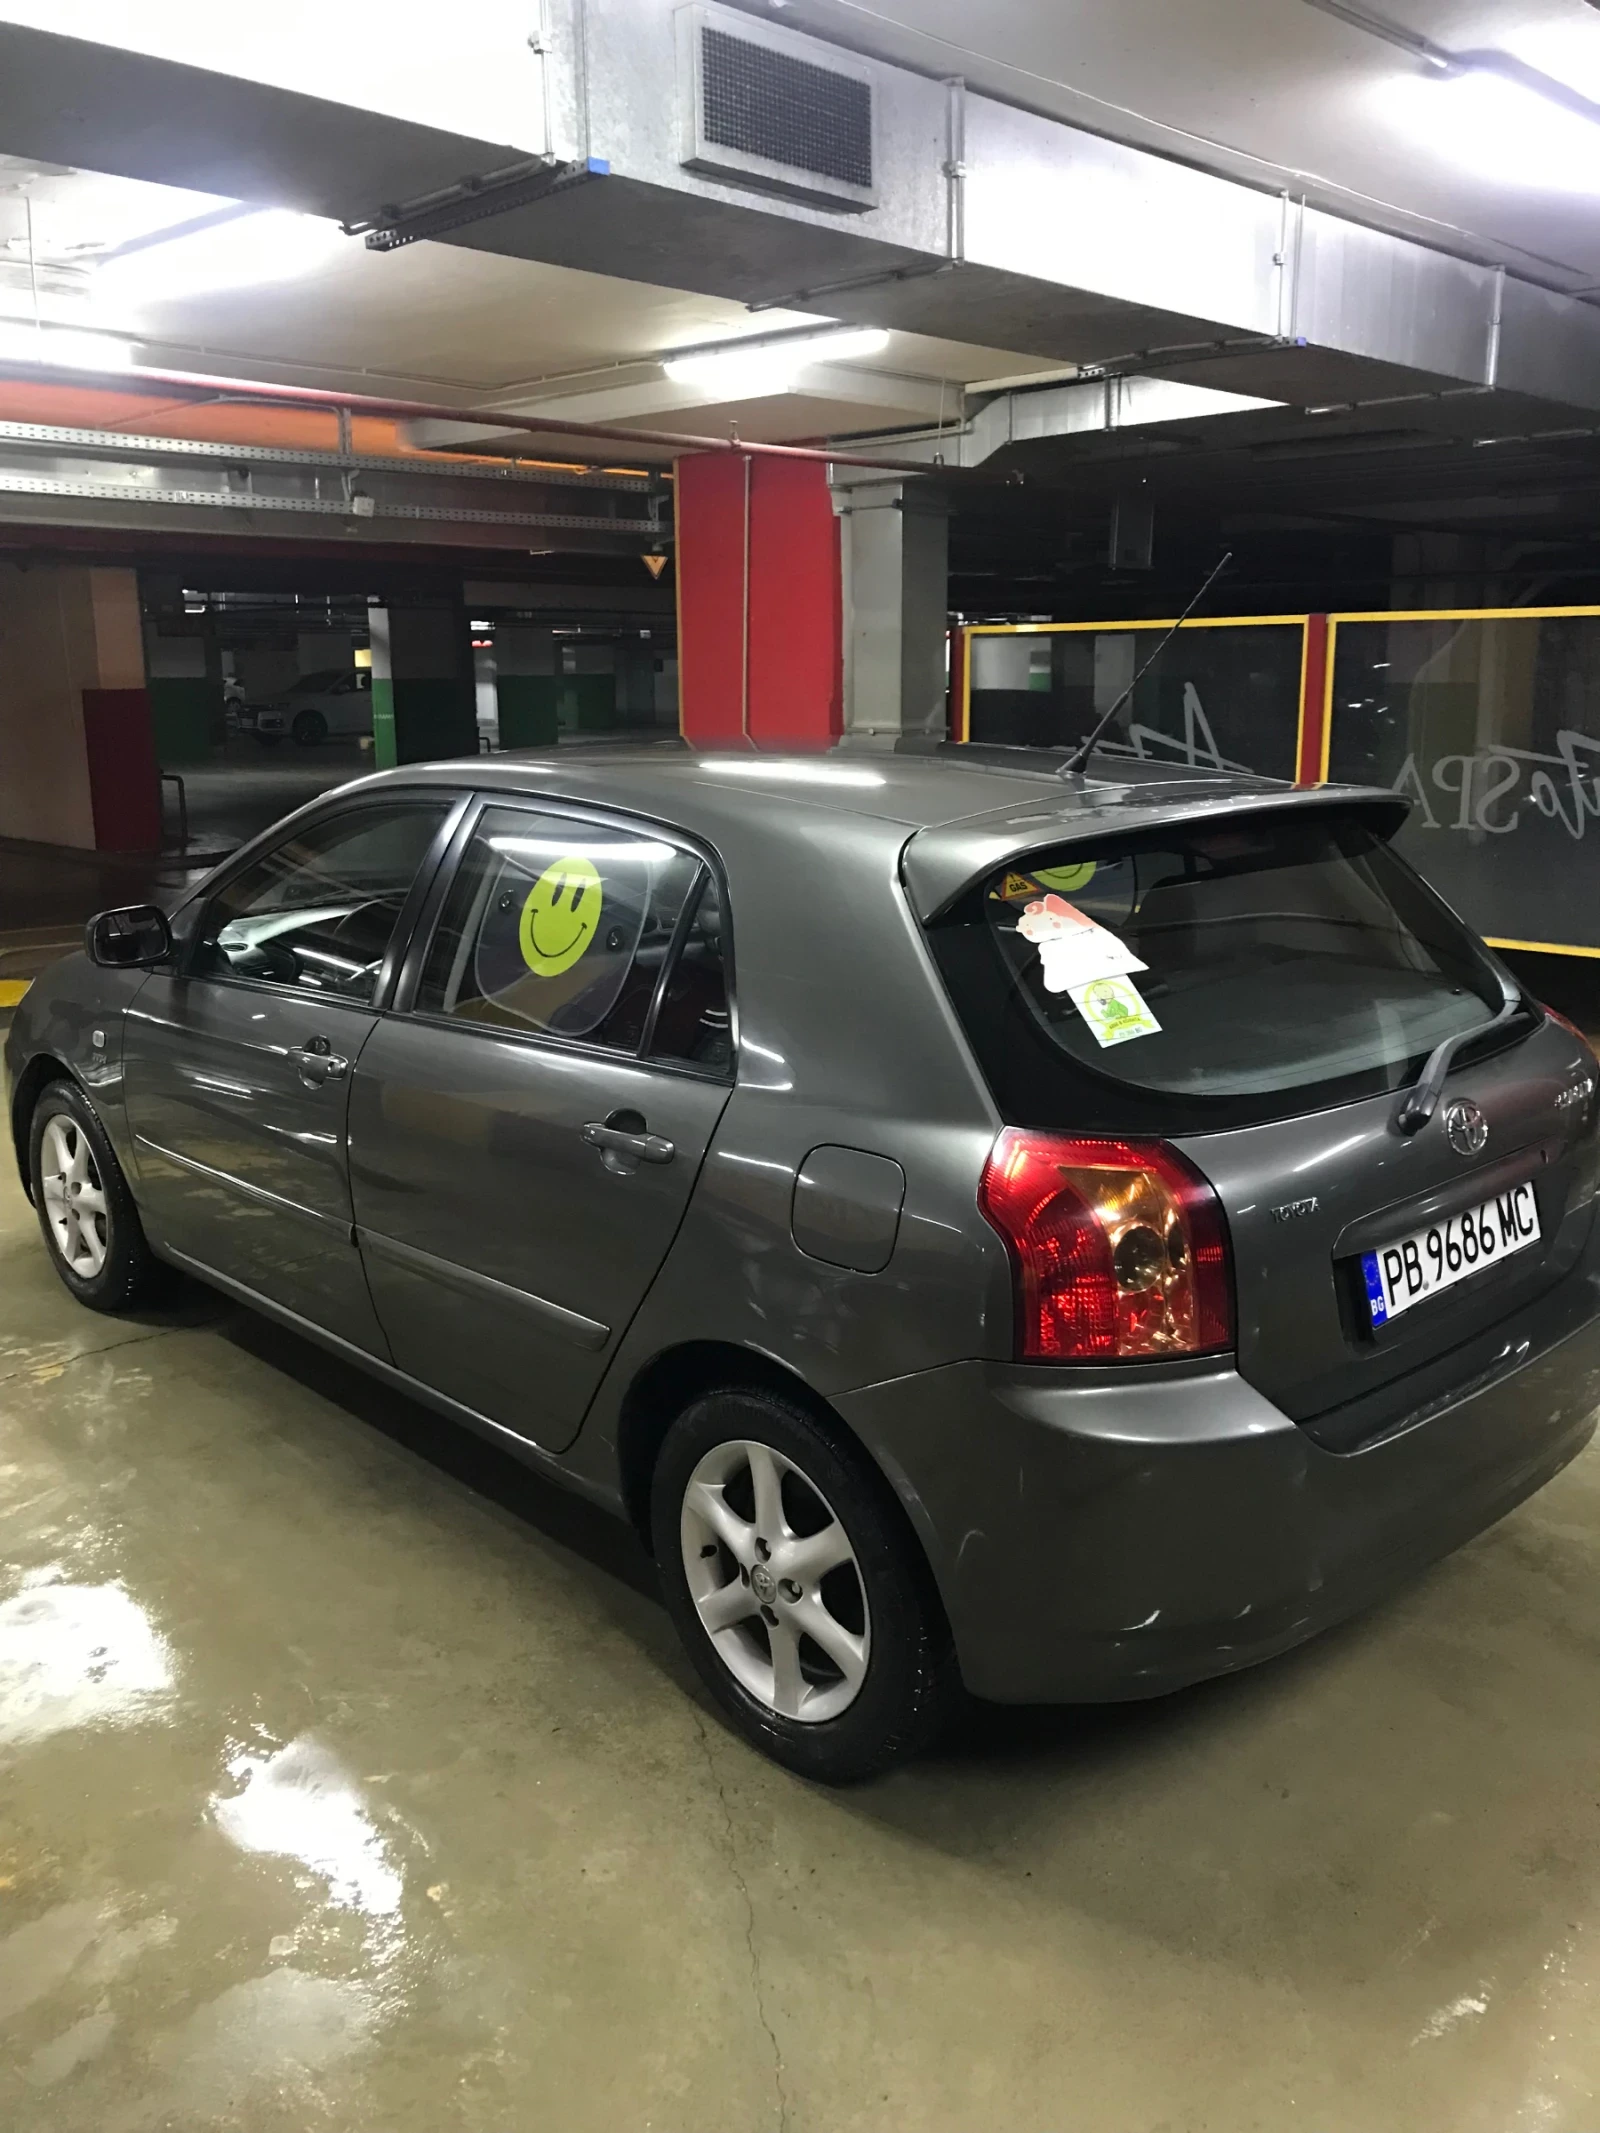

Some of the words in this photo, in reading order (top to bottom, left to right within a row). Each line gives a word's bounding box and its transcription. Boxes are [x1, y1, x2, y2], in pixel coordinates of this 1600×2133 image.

[1008, 881, 1028, 893] GAS
[1269, 1196, 1321, 1223] TOYOTA
[1384, 1240, 1423, 1307] PB
[1427, 1209, 1496, 1281] 9686
[1496, 1186, 1534, 1248] MC
[1371, 1294, 1385, 1317] BG
